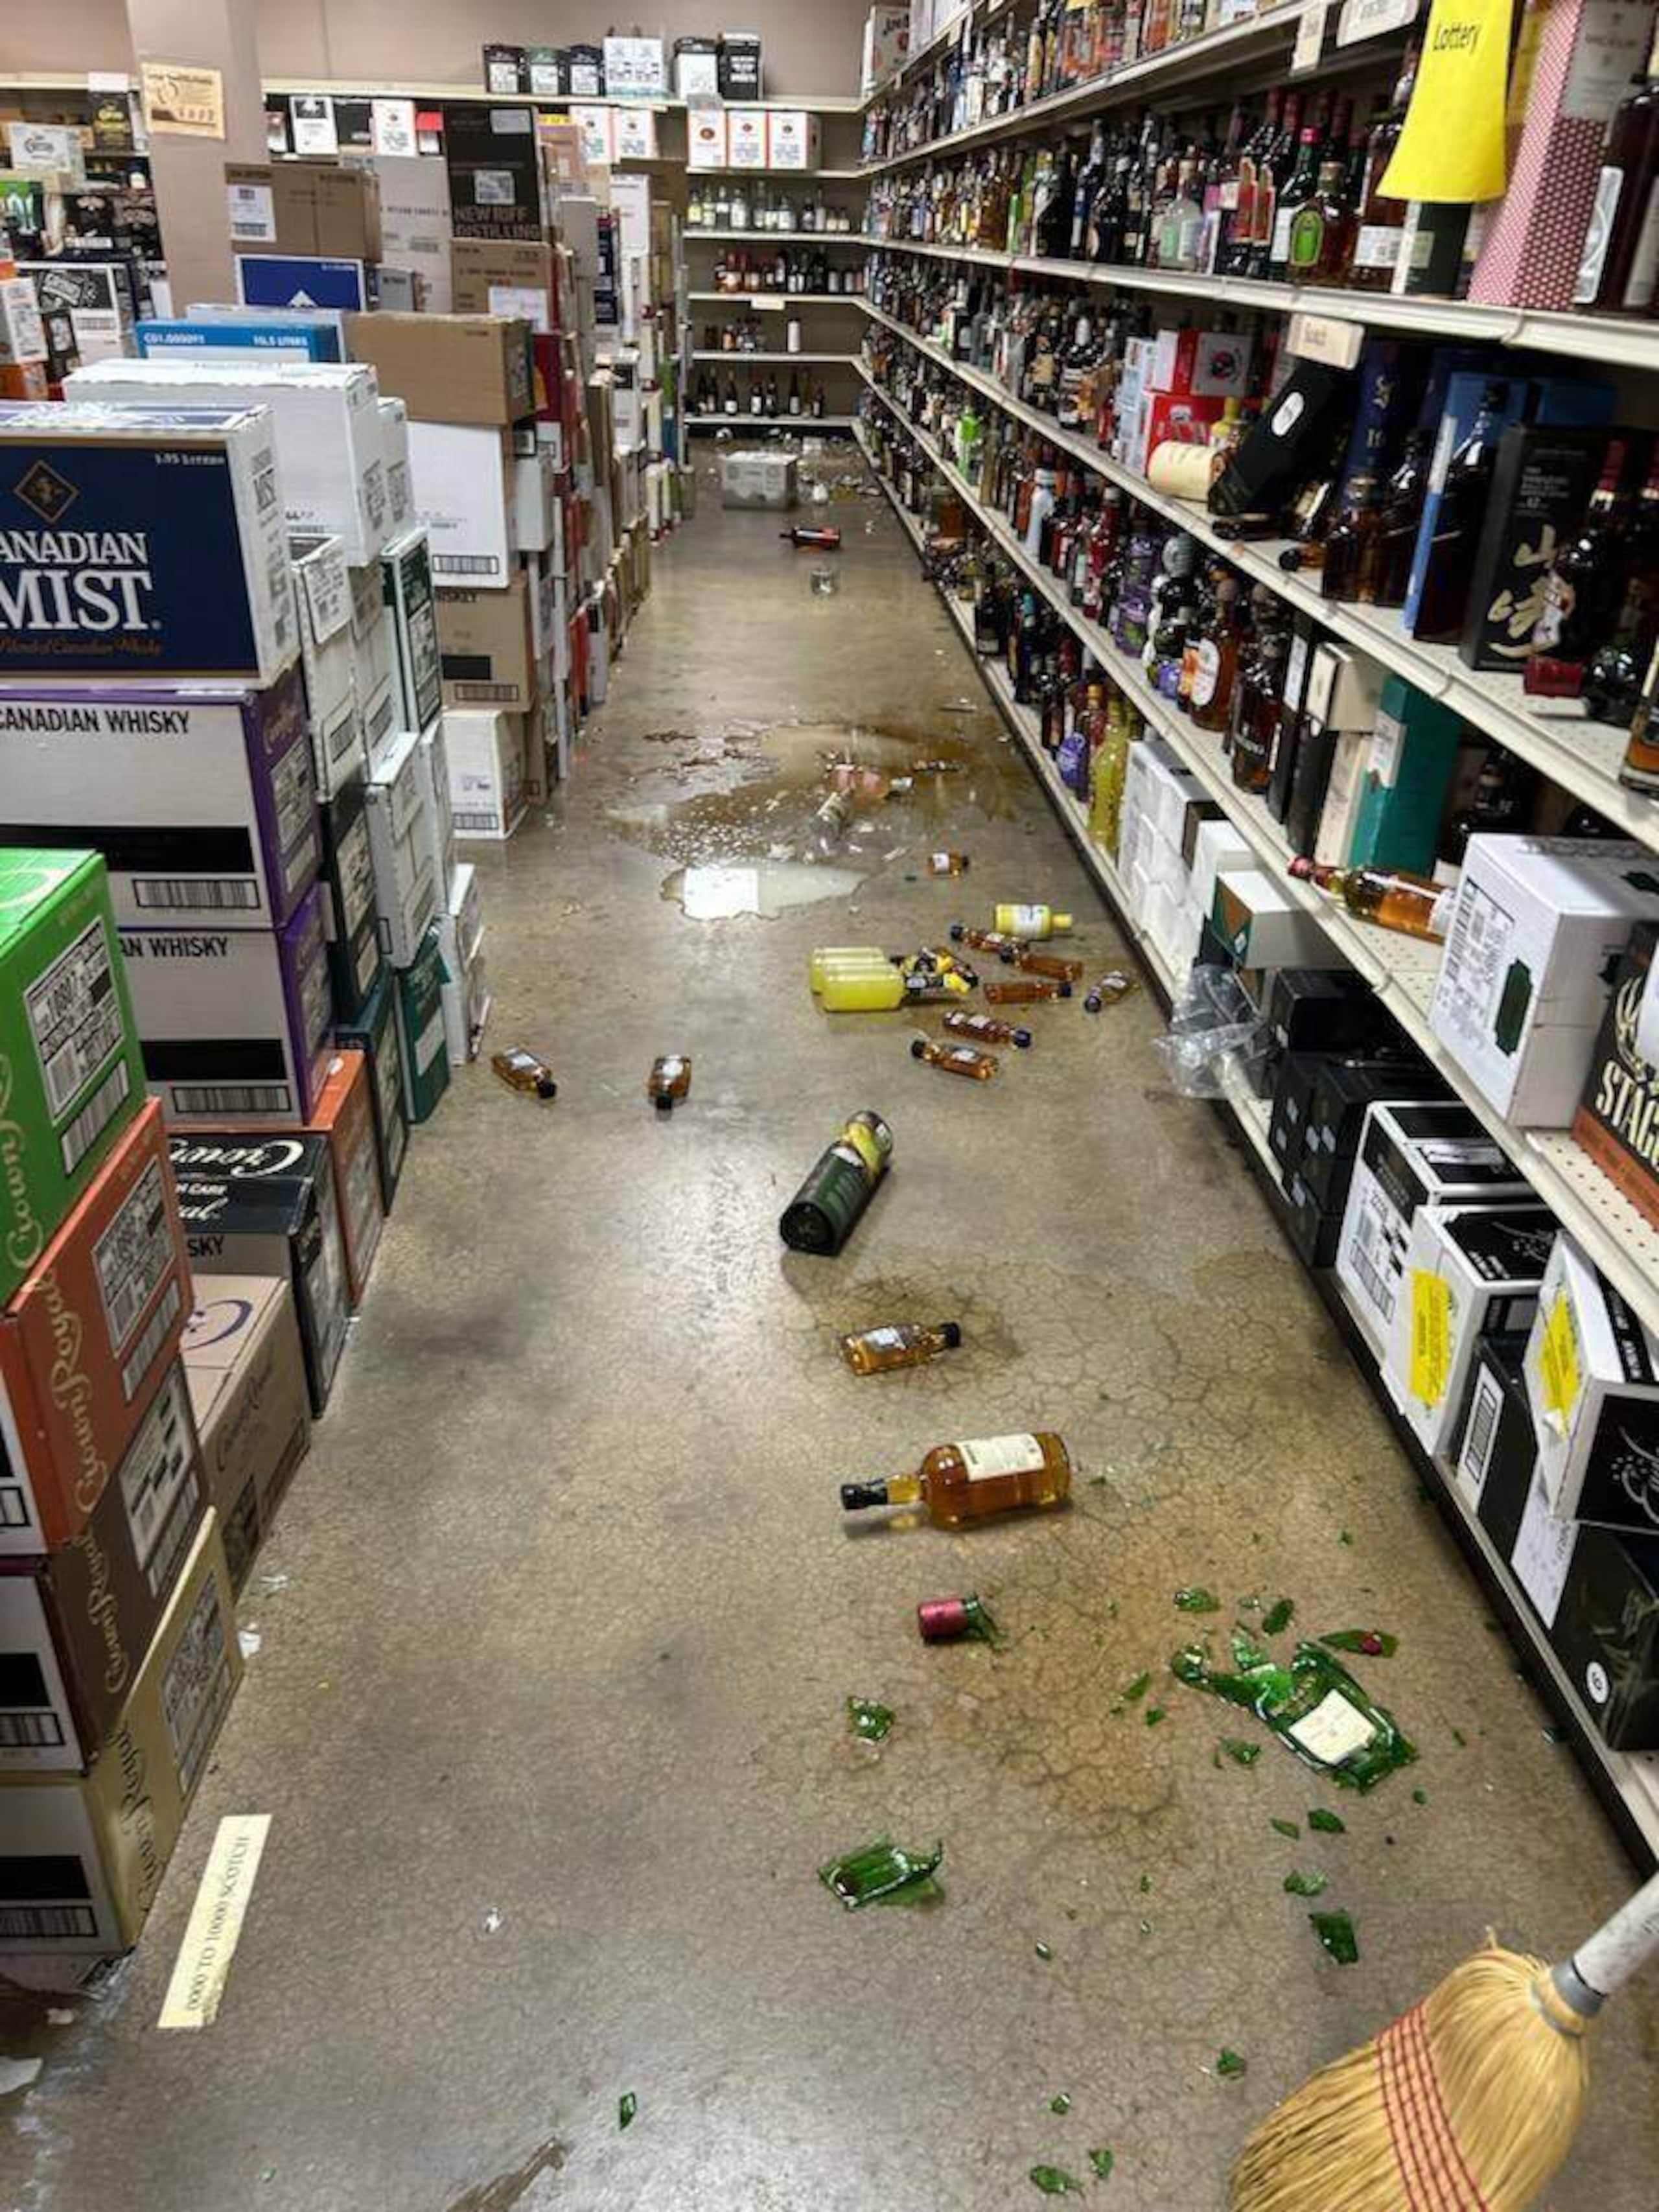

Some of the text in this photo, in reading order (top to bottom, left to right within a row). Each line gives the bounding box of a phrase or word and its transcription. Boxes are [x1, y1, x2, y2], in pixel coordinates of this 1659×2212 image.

[1433, 19, 1482, 55] Lottery
[0, 530, 148, 565] ANADIAN
[104, 710, 190, 734] WHISKY
[149, 937, 228, 957] WHISKY
[187, 1235, 225, 1258] SKY
